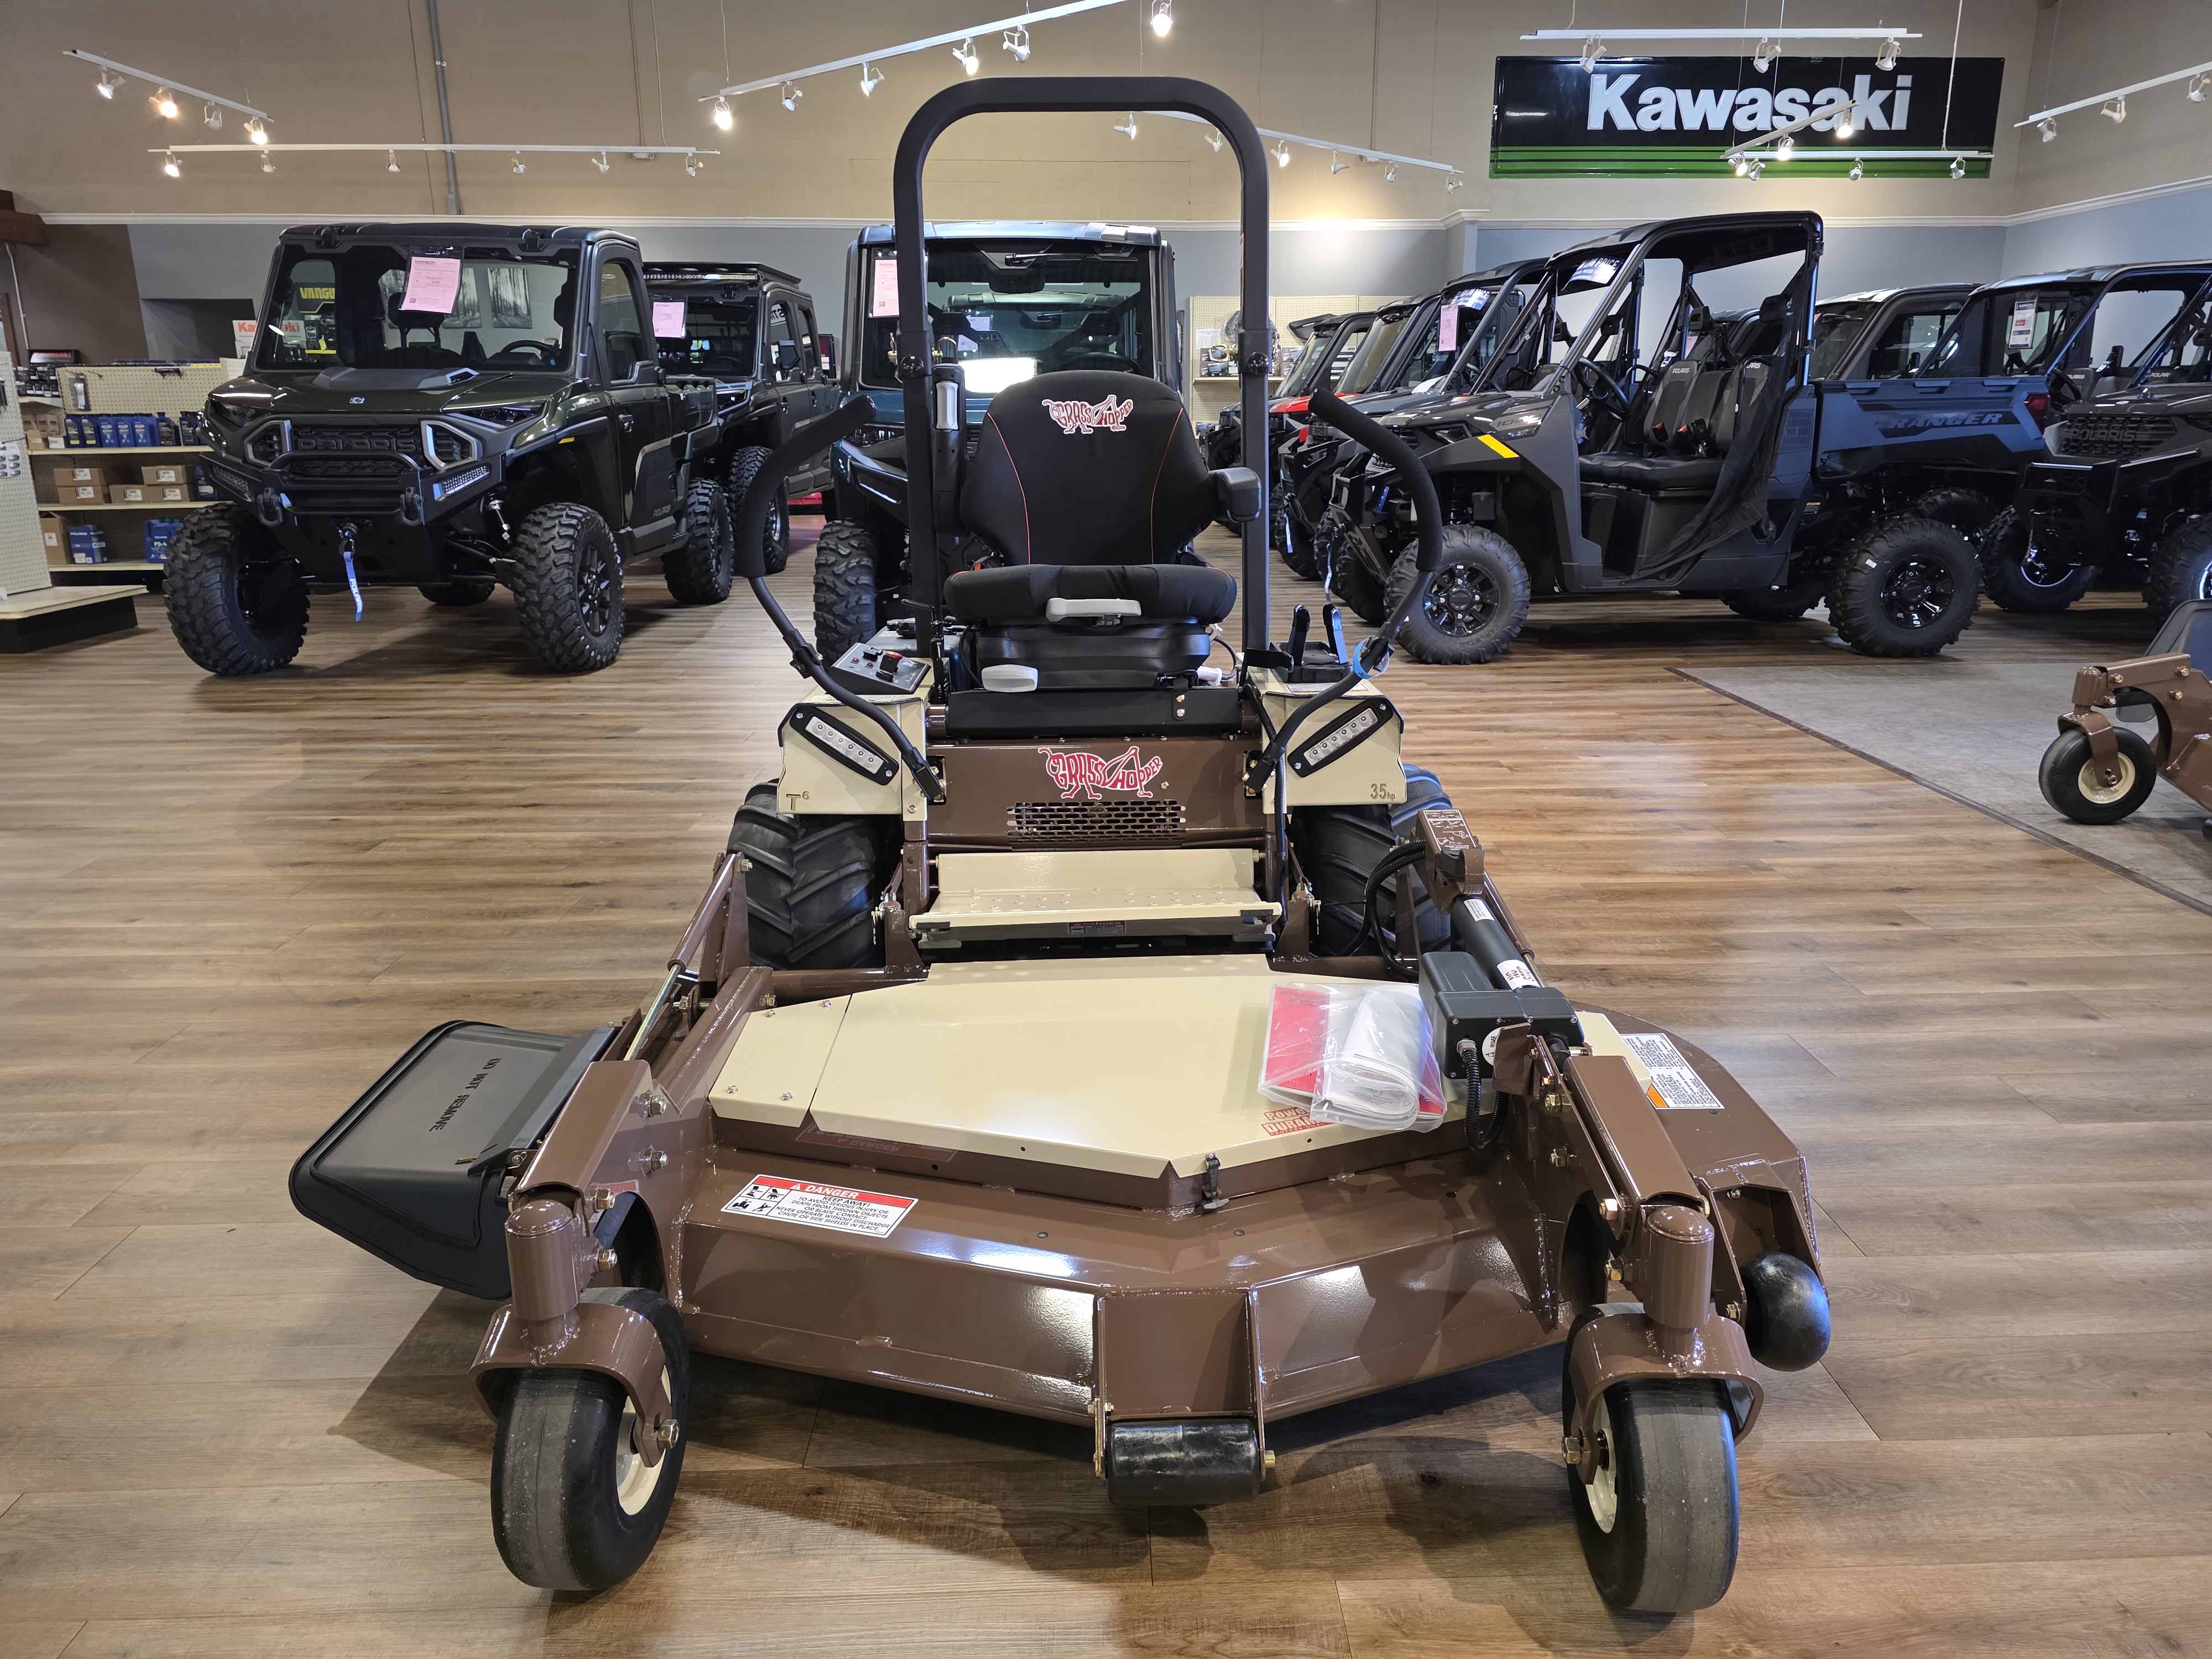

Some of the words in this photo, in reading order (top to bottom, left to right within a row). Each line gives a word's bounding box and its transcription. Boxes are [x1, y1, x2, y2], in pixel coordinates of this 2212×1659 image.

[1587, 74, 1913, 132] Kawasaki
[238, 322, 300, 332] Kaaki
[1888, 413, 2003, 429] RANGER
[2069, 428, 2137, 442] POLARIS
[295, 434, 416, 453] POLARIS
[653, 504, 671, 518] POLARIS
[349, 578, 363, 613] POLARI
[483, 1058, 501, 1070] DO
[465, 1073, 488, 1089] NOT
[429, 1094, 470, 1132] REMOVE
[1270, 1123, 1325, 1135] PROFESSIONAL
[805, 1183, 859, 1199] DANGER
[853, 1219, 890, 1228] DISCHARGE
